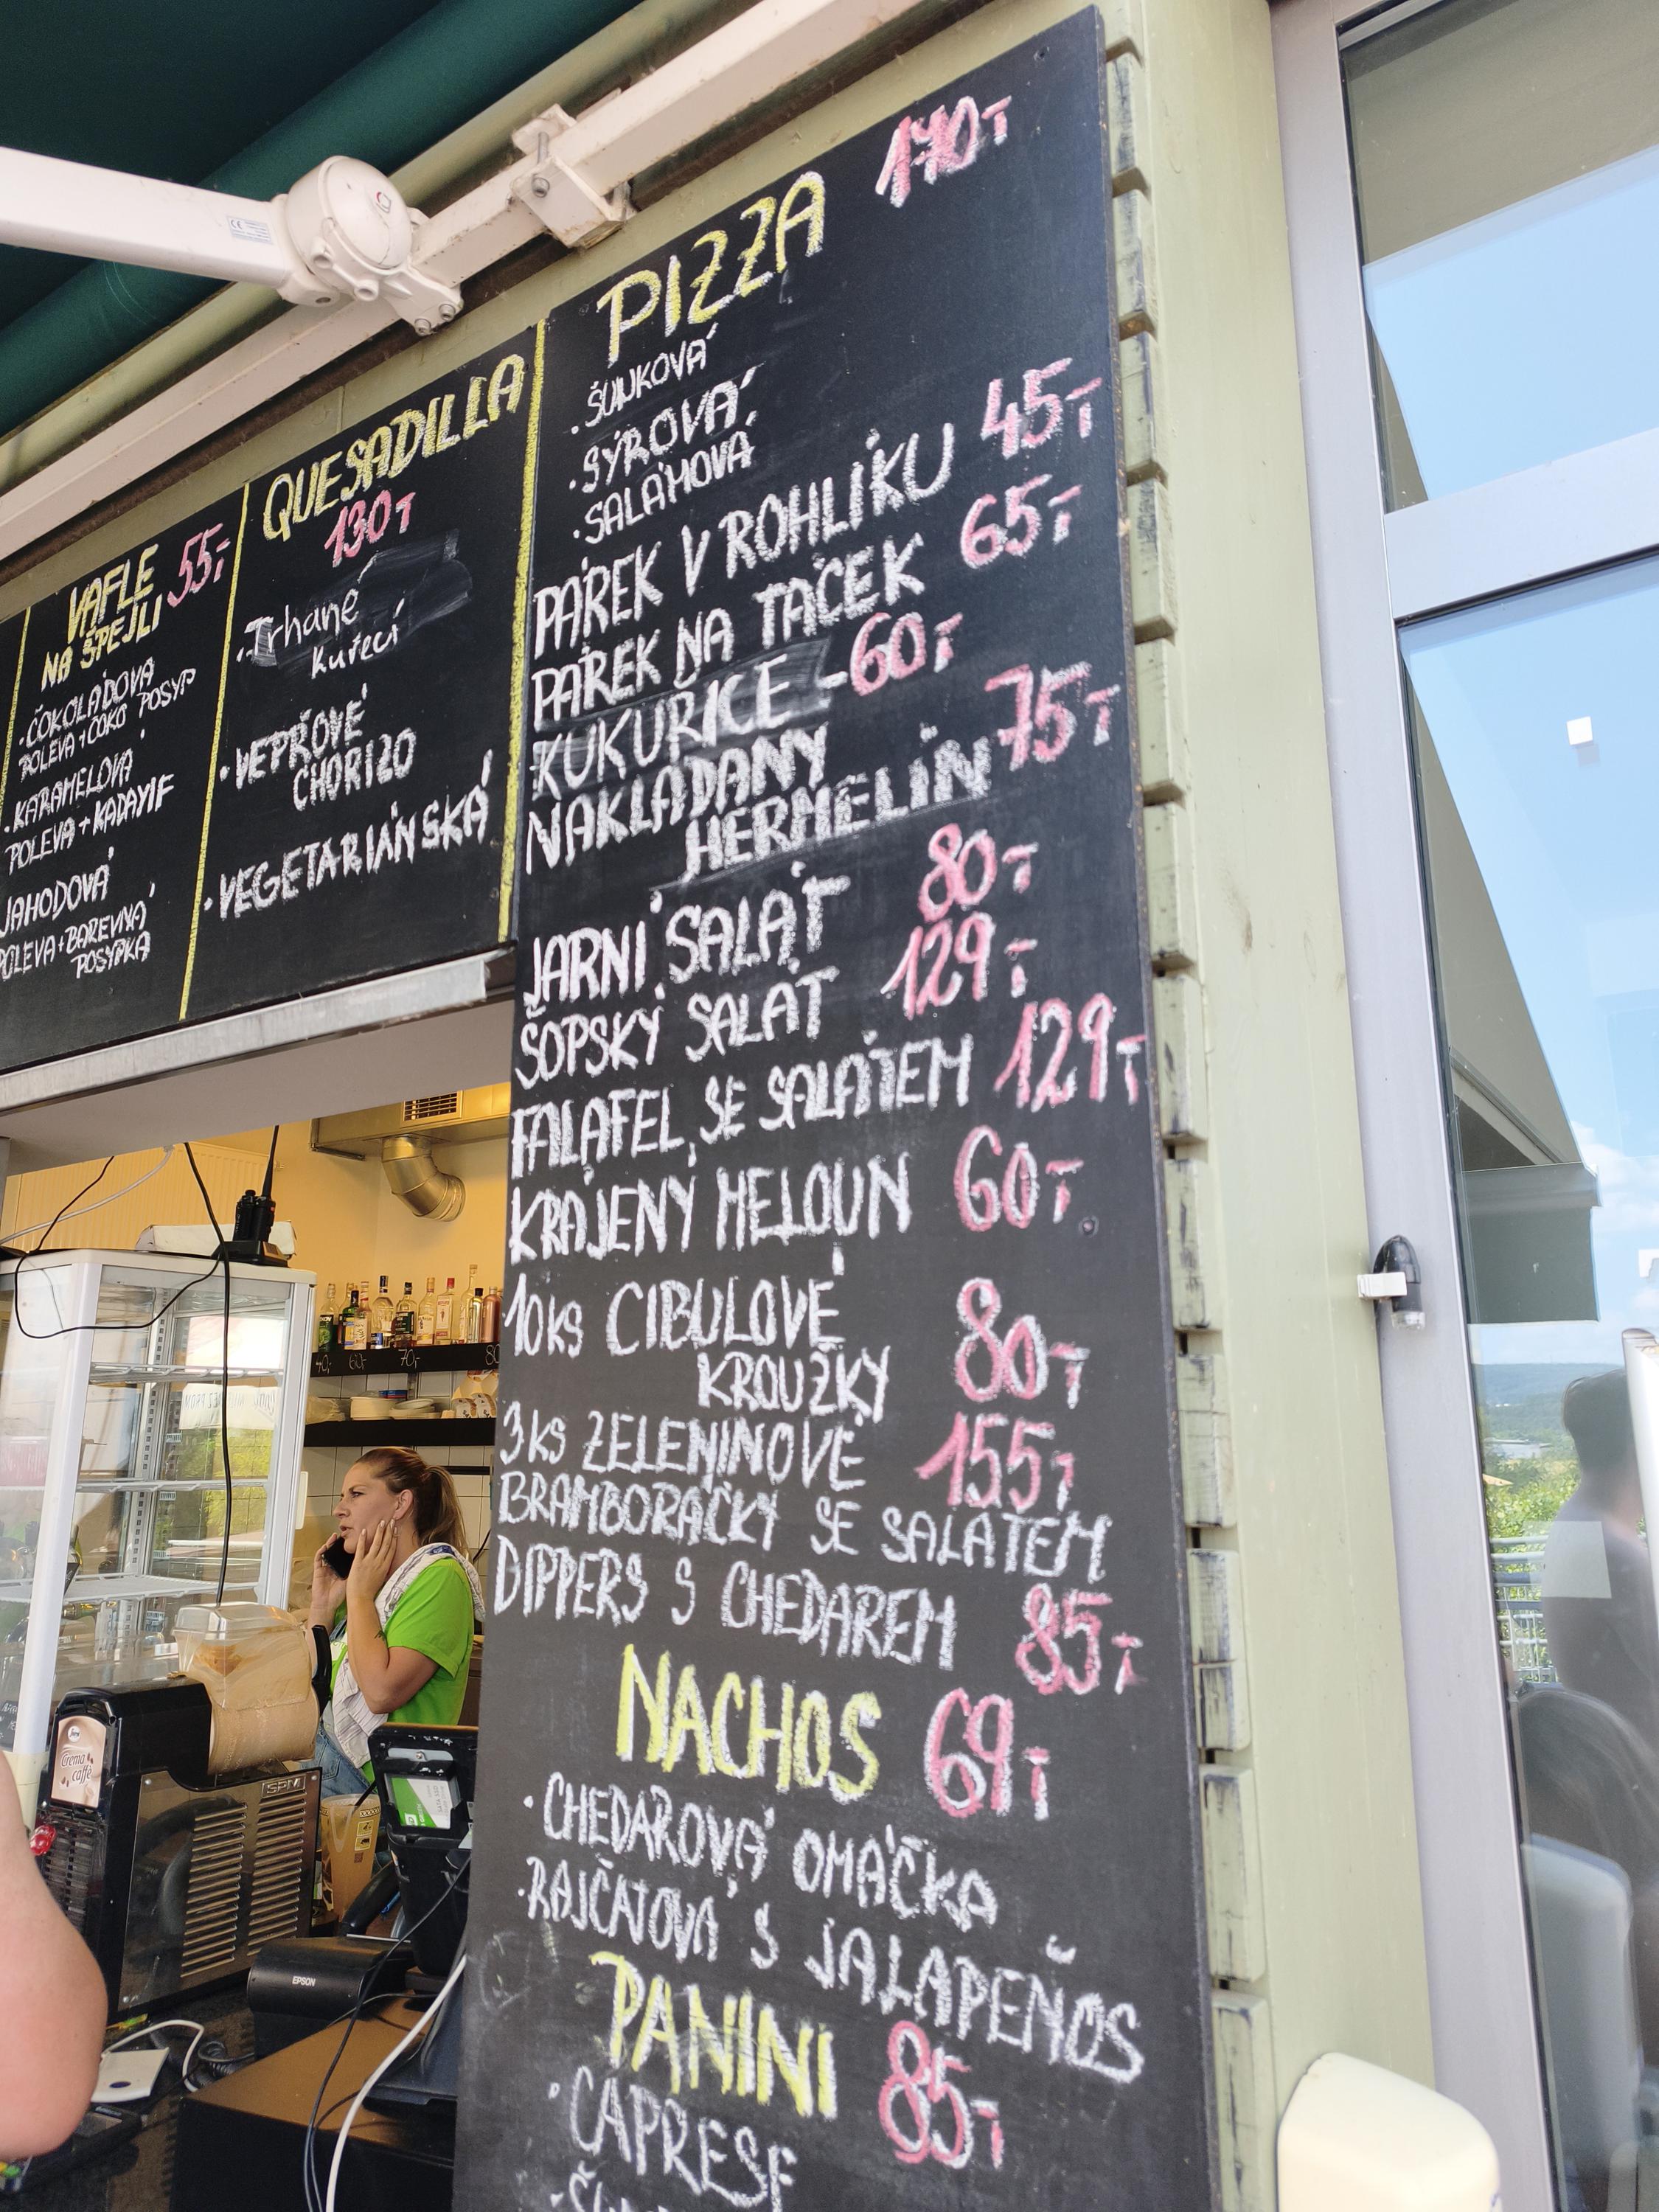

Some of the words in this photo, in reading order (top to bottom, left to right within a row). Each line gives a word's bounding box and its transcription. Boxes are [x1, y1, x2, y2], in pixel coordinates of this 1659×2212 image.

[597, 171, 825, 367] PIZZA
[263, 354, 526, 542] QUESADILLA
[68, 543, 159, 644] VAFLE
[681, 525, 711, 597] V
[41, 646, 73, 692] NA
[674, 608, 735, 689] NA
[18, 732, 74, 782] POLEVA
[136, 668, 196, 718] POSYP
[293, 727, 417, 812] CHORIZO
[4, 817, 75, 875] POLEVA
[70, 931, 151, 979] POSYPKA
[511, 1087, 686, 1179] FALAFEL
[700, 1075, 746, 1144] SE
[810, 1496, 862, 1555] SE
[494, 1534, 649, 1627] DIPPERS
[671, 1557, 696, 1626] S
[720, 1559, 958, 1671] CHEDAREM
[61, 1752, 86, 1767] Crema
[616, 1643, 882, 1805] NACHOS
[266, 1778, 302, 1795] SPM
[292, 1976, 316, 1987] EPSON
[590, 1950, 838, 2120] PANINI
